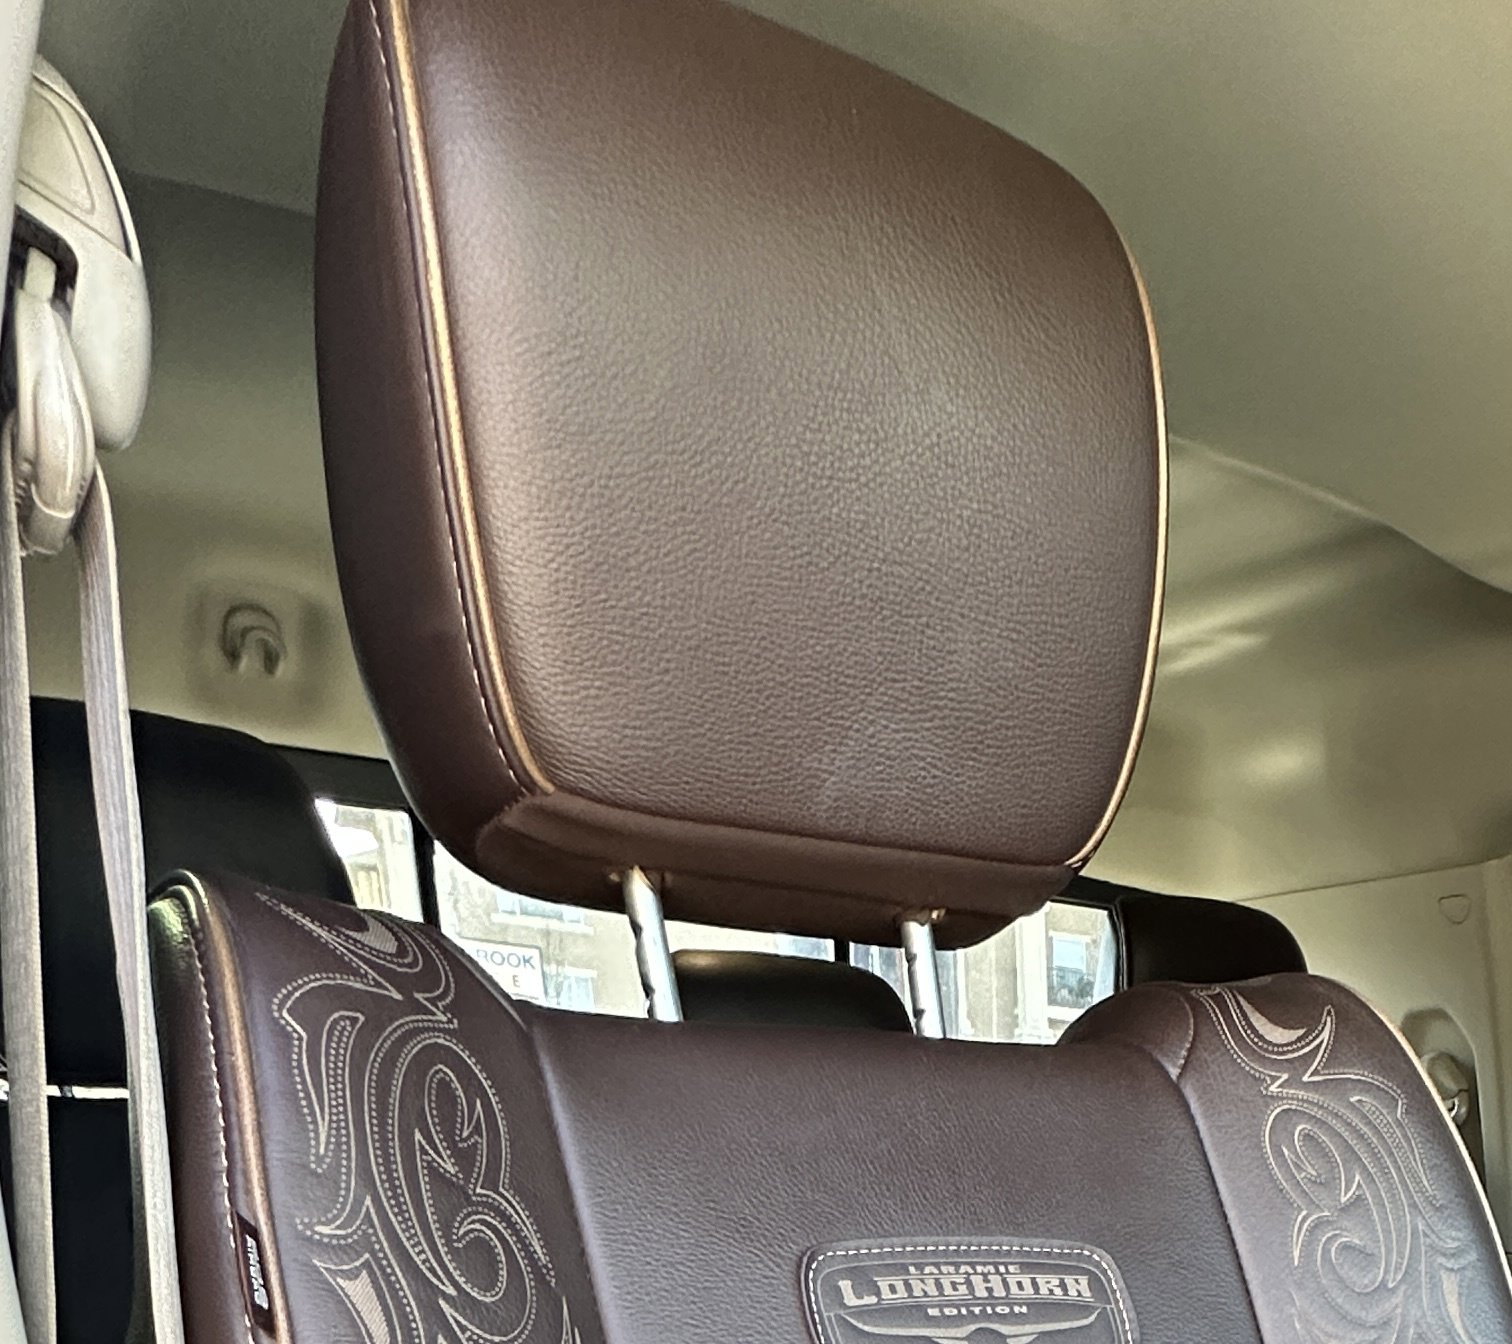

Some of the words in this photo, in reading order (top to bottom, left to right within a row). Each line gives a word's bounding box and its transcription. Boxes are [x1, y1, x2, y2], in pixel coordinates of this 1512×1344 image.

[908, 1264, 1022, 1275] LARAMIE
[838, 1273, 1093, 1307] LONGHORN
[927, 1305, 1029, 1317] EDITION
